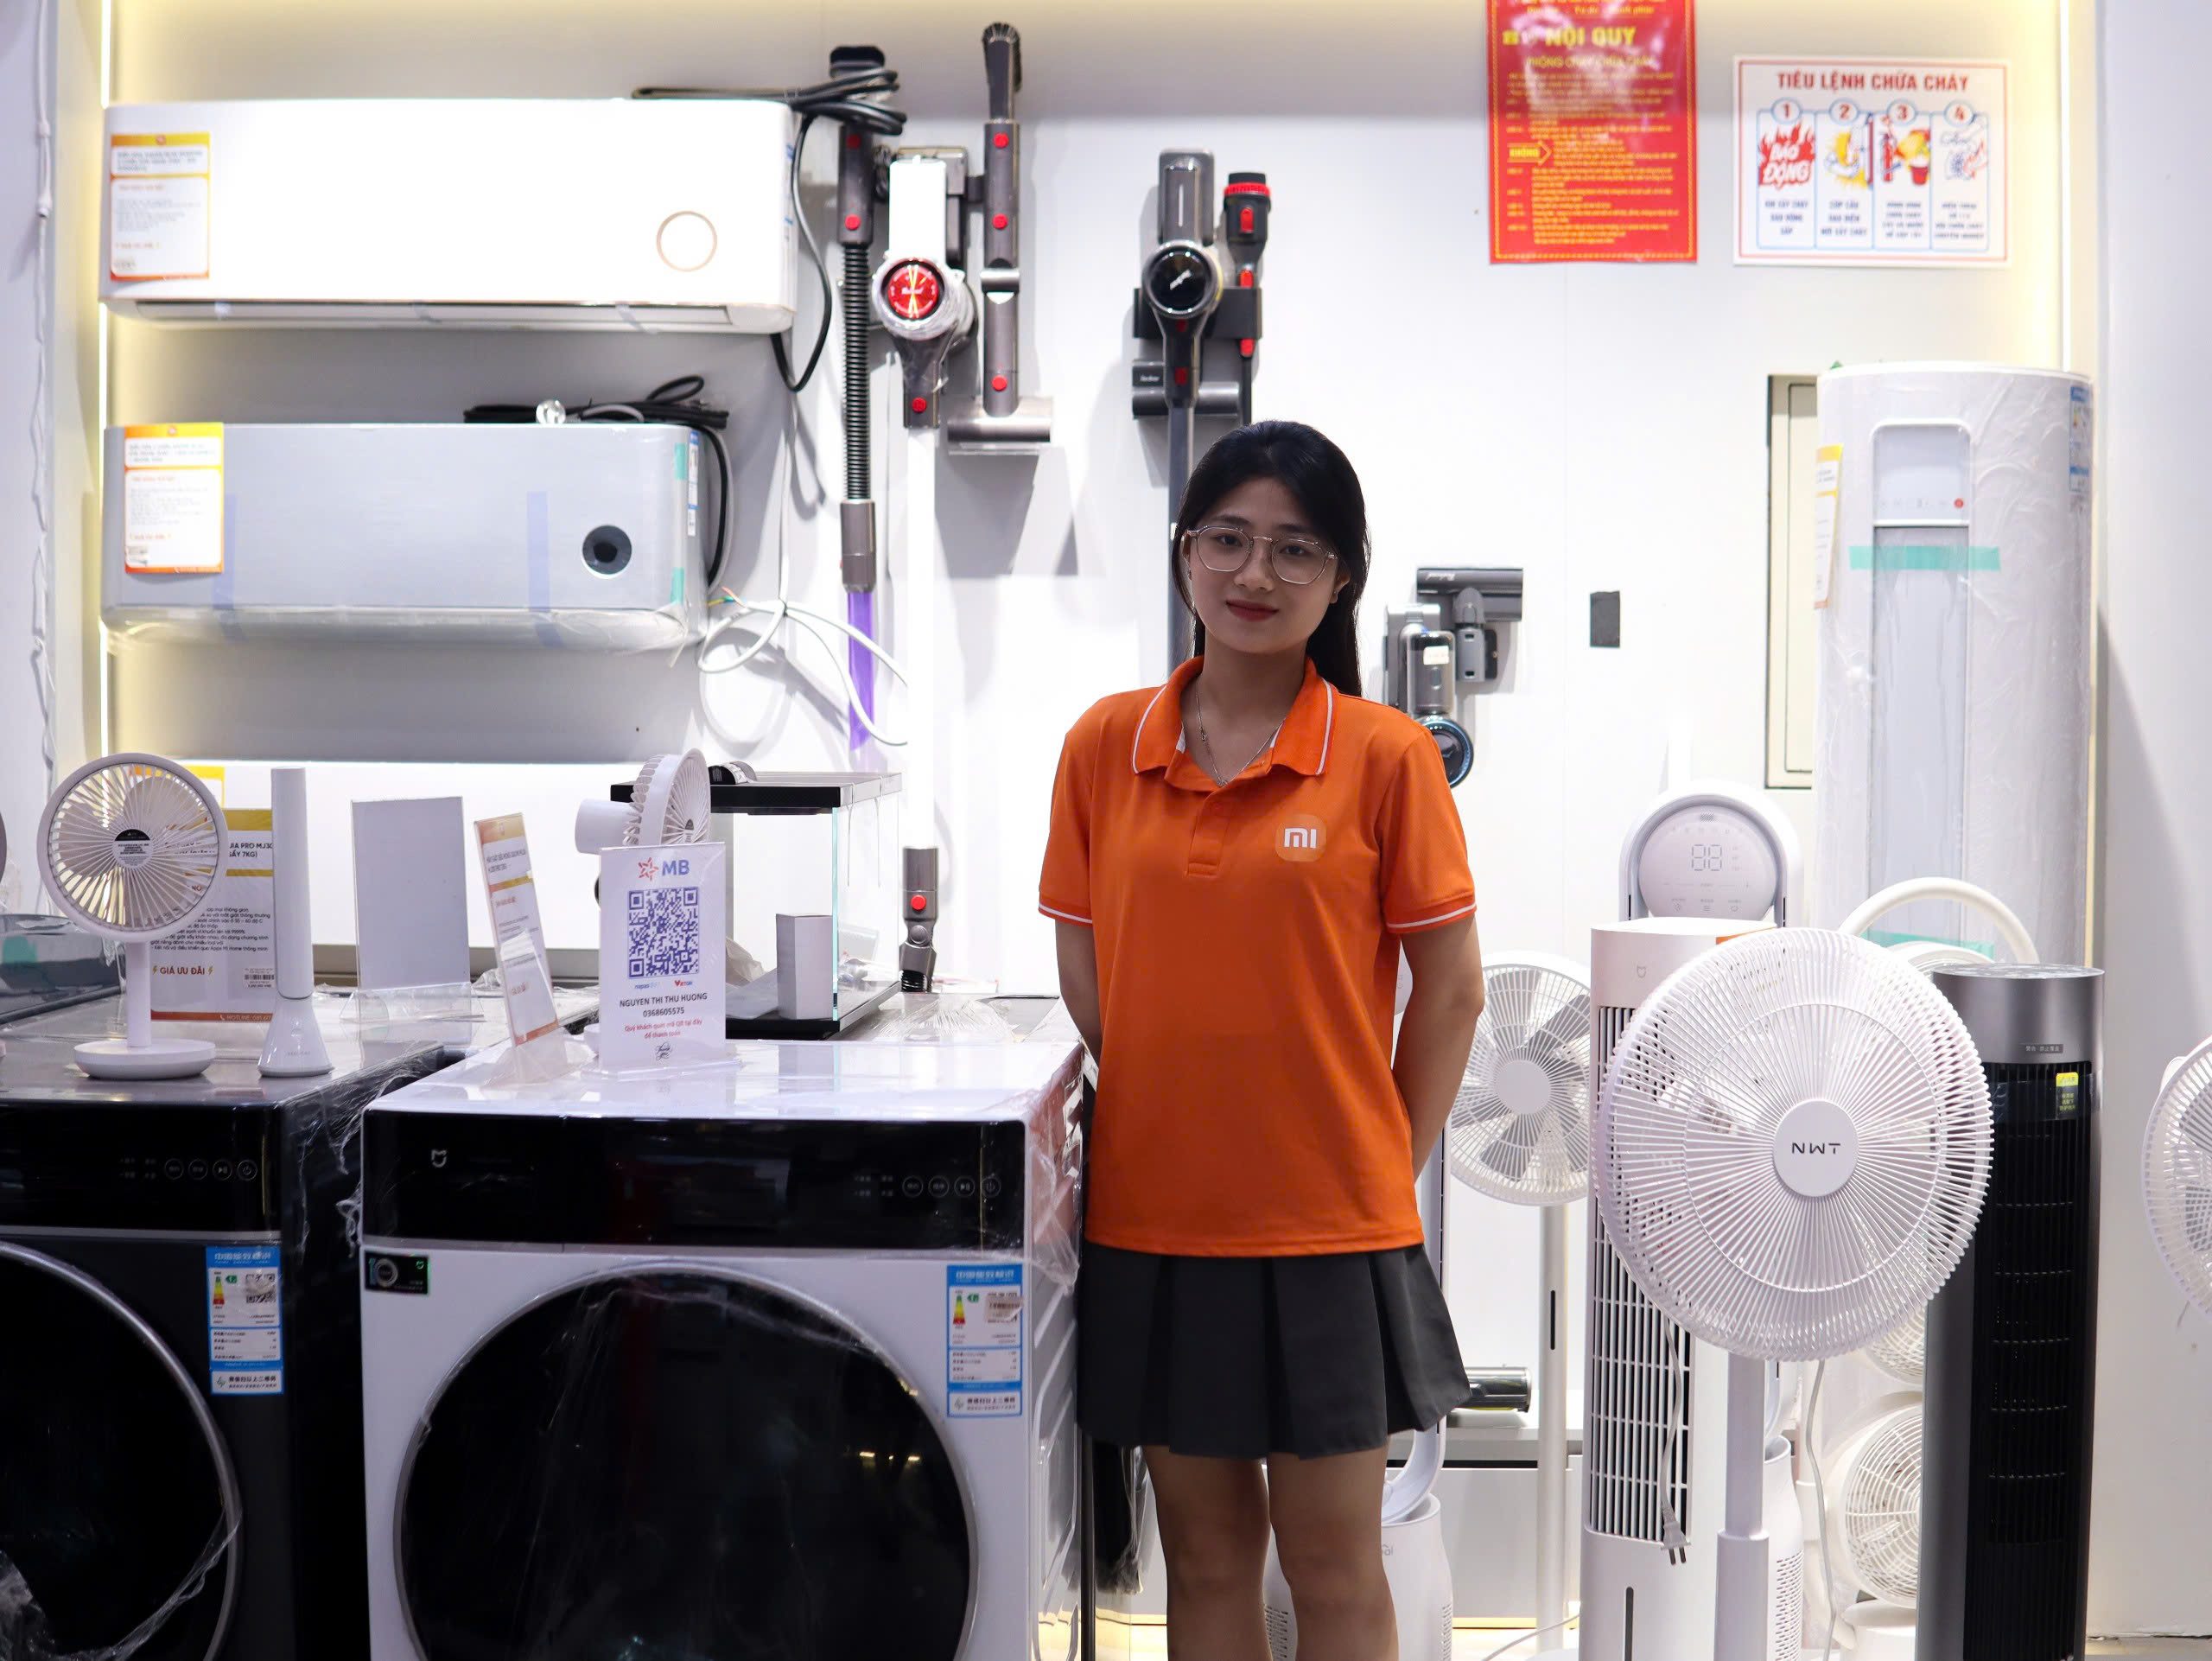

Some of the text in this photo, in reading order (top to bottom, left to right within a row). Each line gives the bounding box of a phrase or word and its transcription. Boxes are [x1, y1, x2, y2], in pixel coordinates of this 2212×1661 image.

[1783, 103, 1964, 121] 1 2 3 4
[662, 859, 690, 876] MB
[159, 965, 175, 975] GIÁ
[191, 965, 205, 975] ĐÃI
[620, 992, 708, 1008] NGUYEN THI THU HUONG
[1791, 1142, 1841, 1155] NWT
